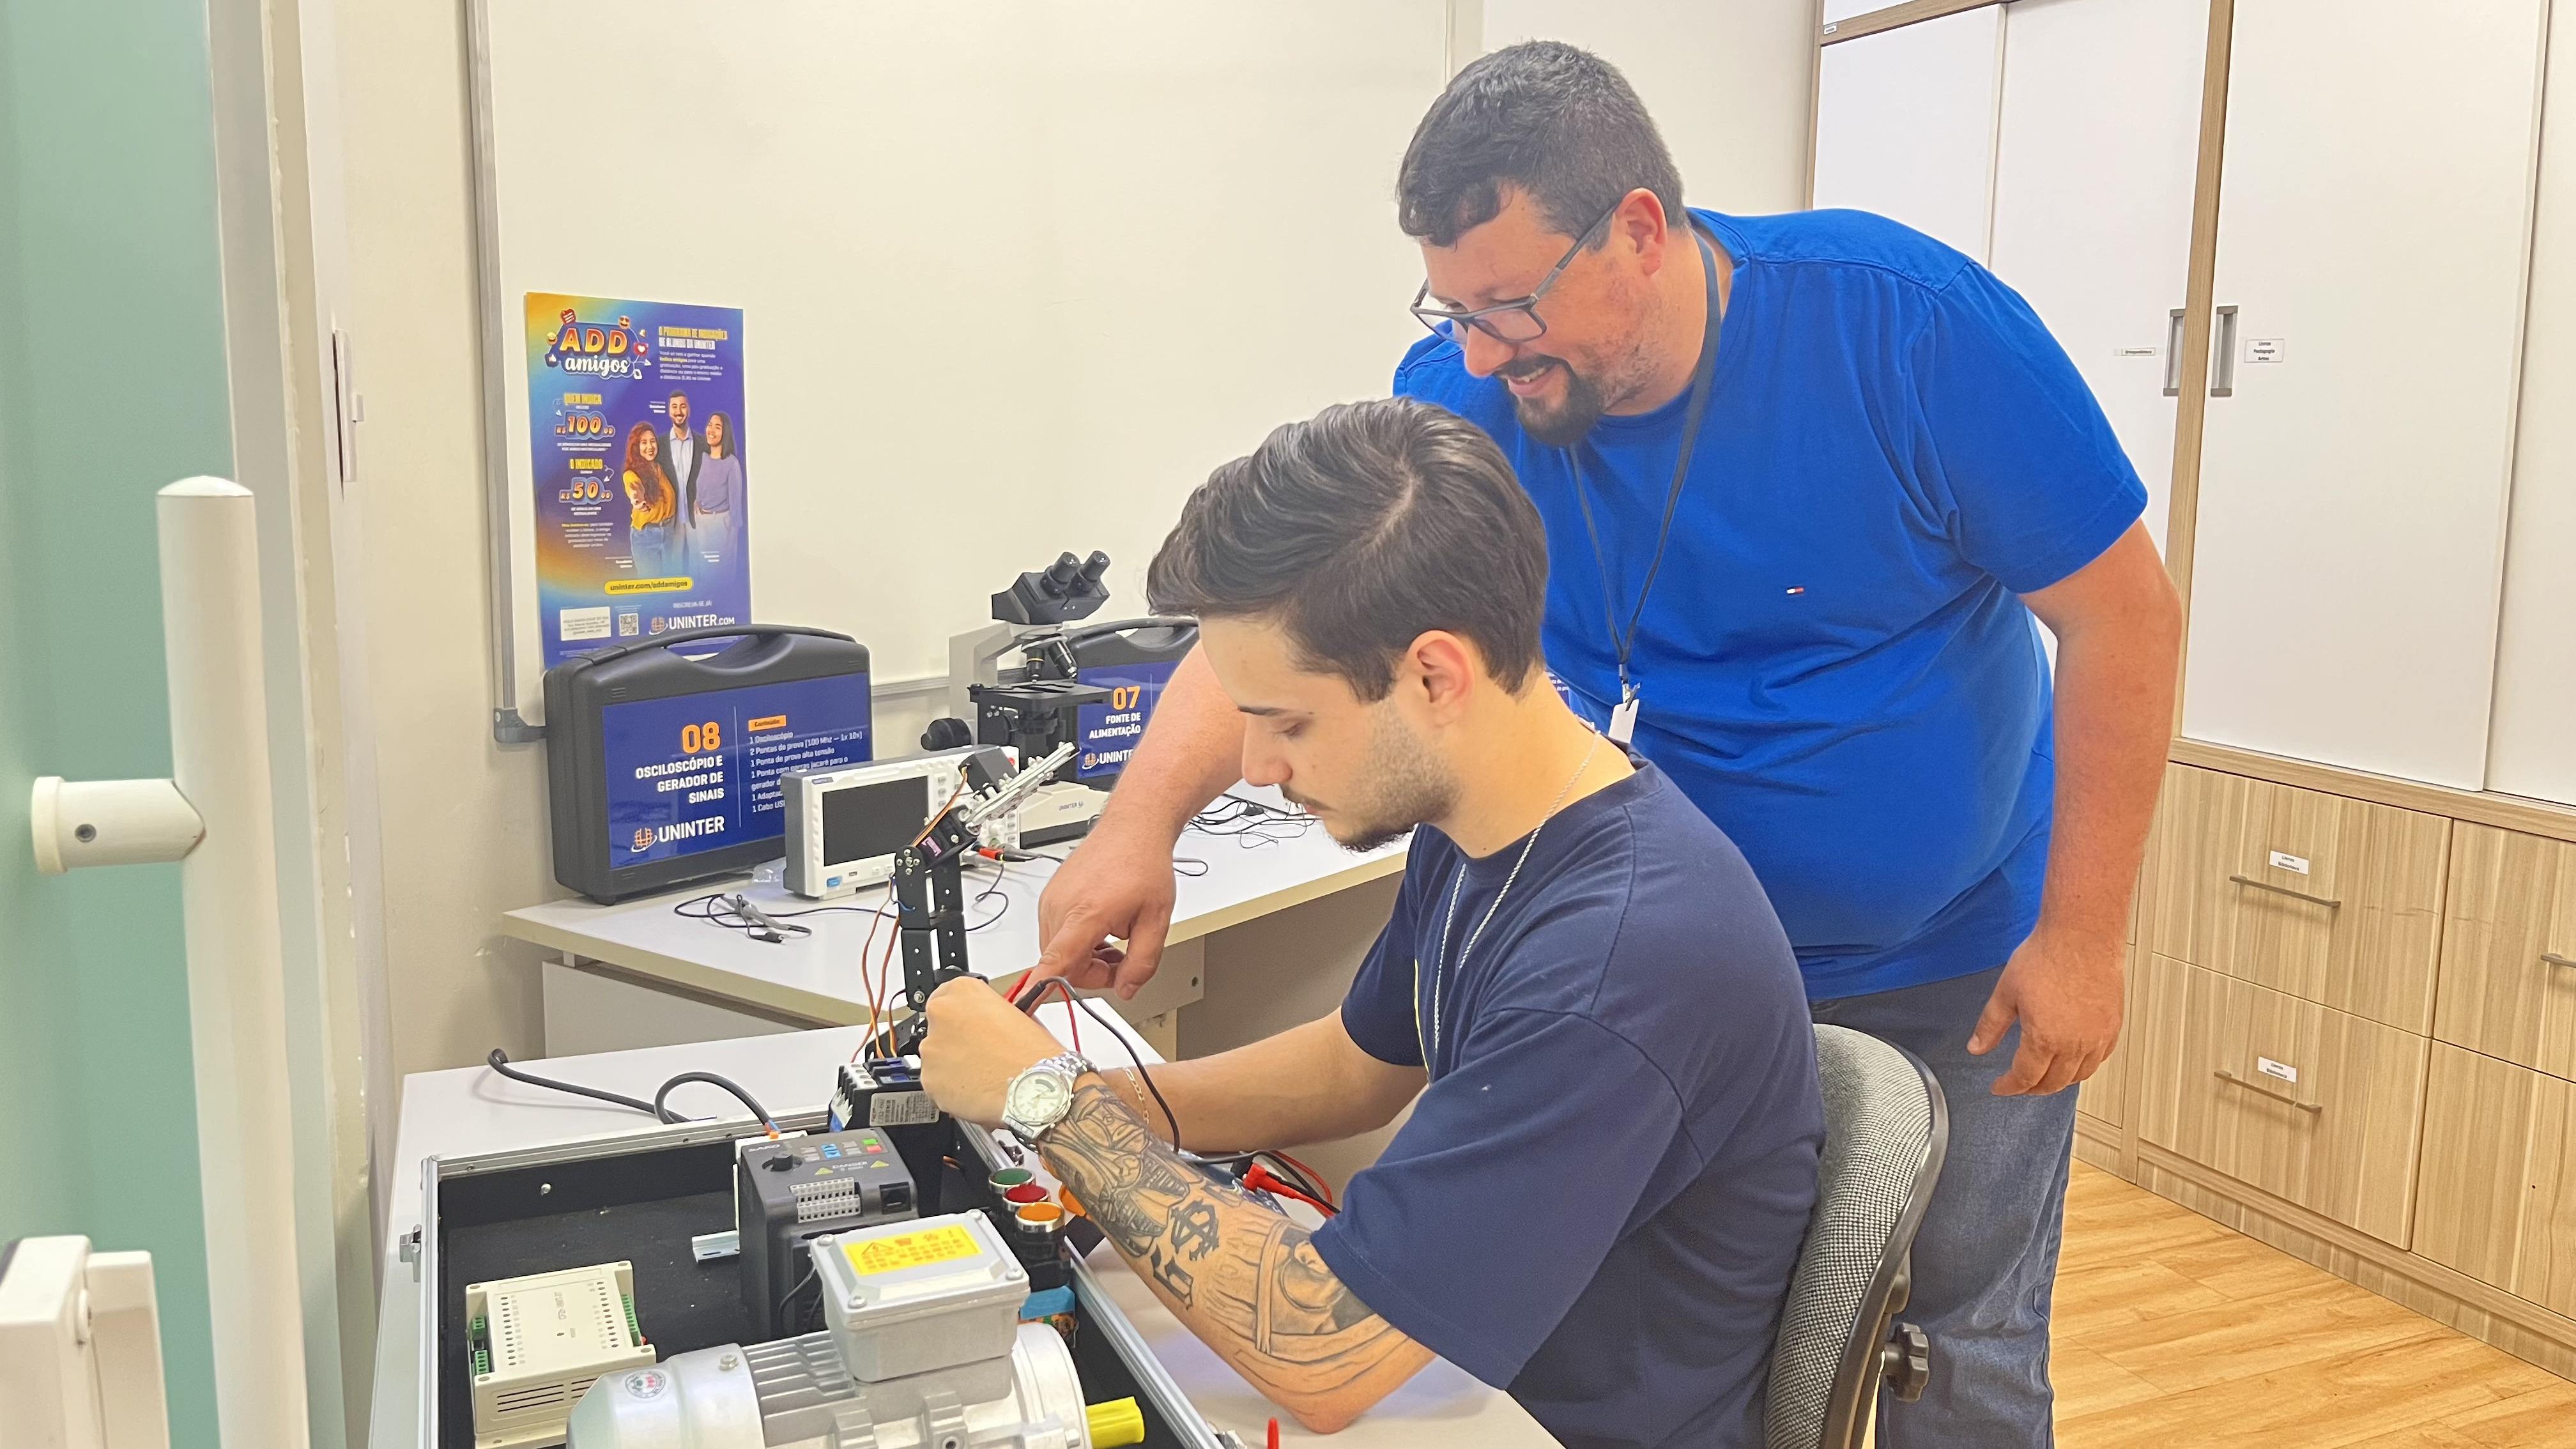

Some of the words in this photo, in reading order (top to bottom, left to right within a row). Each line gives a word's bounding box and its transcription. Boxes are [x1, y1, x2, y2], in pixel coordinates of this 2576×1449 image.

[560, 328, 627, 355] ADD
[565, 355, 630, 376] amigos
[568, 416, 601, 433] 100
[572, 481, 599, 499] 50
[1113, 686, 1140, 710] 07
[1106, 714, 1130, 724] FONTE
[1131, 712, 1141, 722] DE
[682, 721, 721, 754] 08
[755, 732, 793, 744] Osciloscópio
[1089, 723, 1141, 739] ALIMENTAÇÃO
[749, 747, 755, 756] 2
[756, 746, 778, 755] Pontas
[786, 742, 804, 752] prova
[756, 758, 775, 766] Ponta
[784, 753, 801, 763] prova
[815, 747, 835, 756] tensão
[635, 756, 714, 779] OSCILOSCÓPIO
[716, 755, 723, 766] E
[756, 769, 775, 778] Ponta
[657, 774, 707, 792] GERADOR
[710, 771, 723, 784] DE
[689, 787, 724, 804] SINAIS
[752, 793, 756, 802] 1
[758, 803, 774, 811] Cabo
[659, 816, 724, 842] UNINTER
